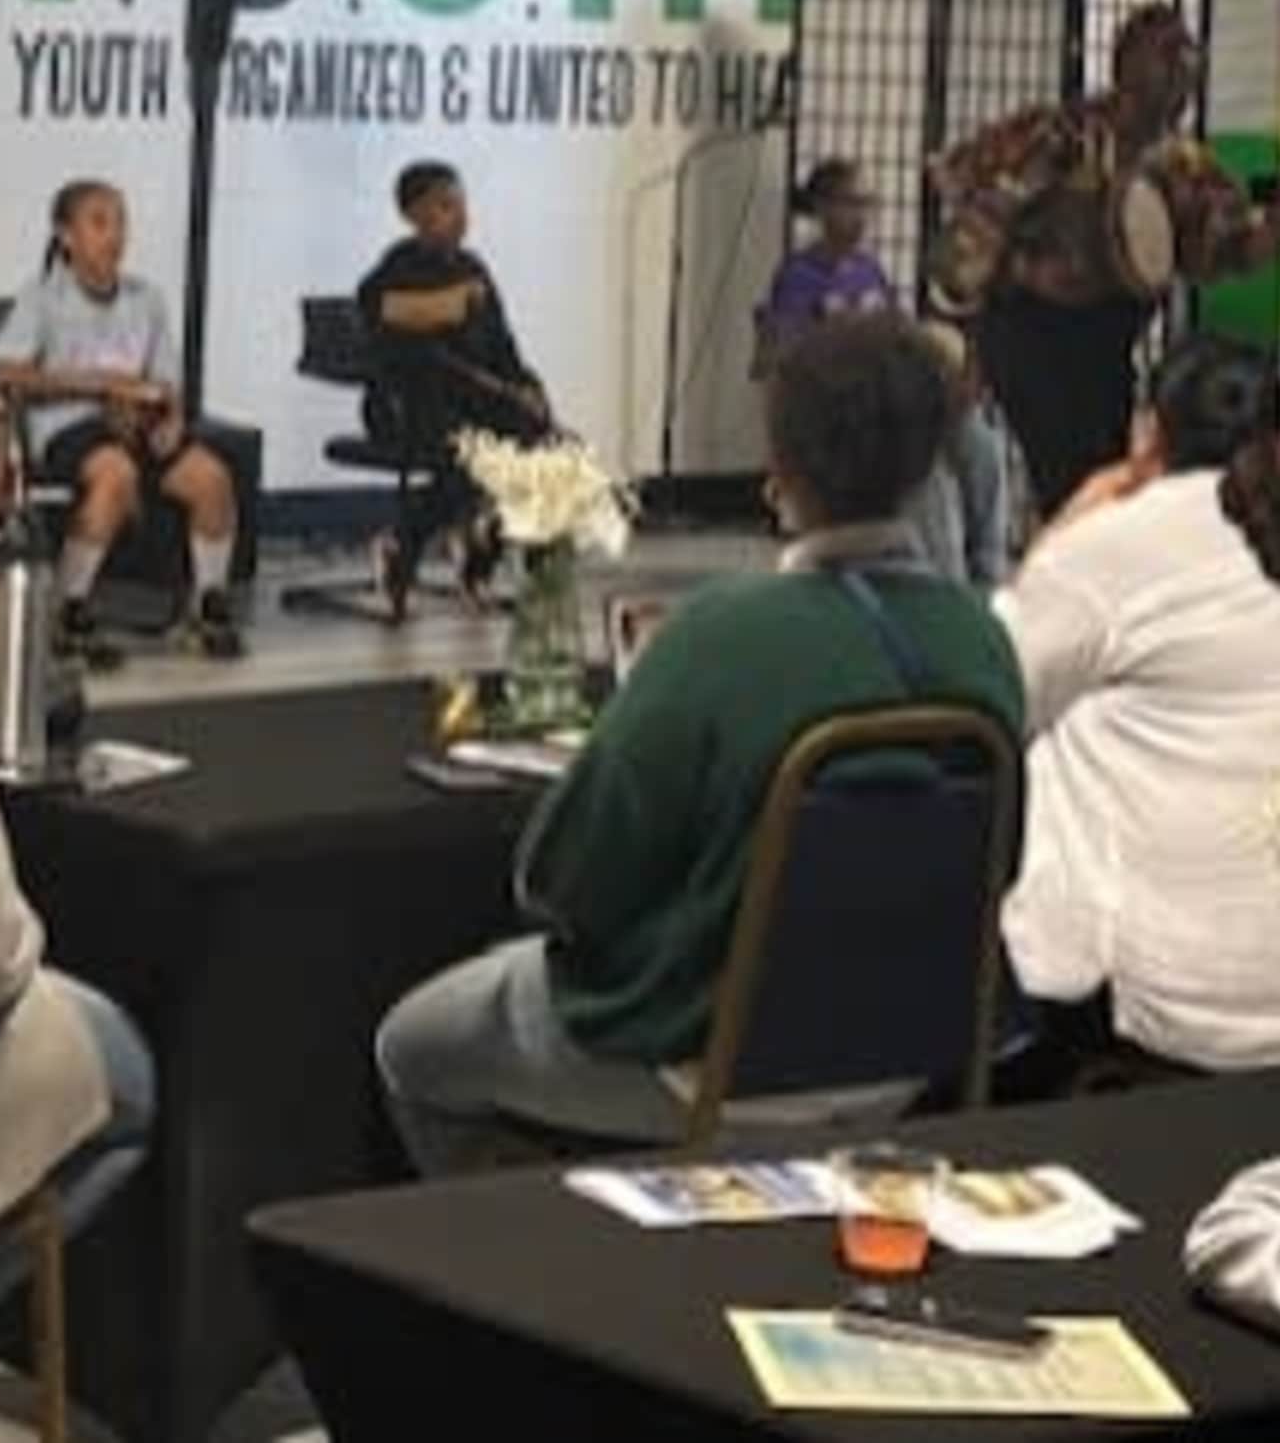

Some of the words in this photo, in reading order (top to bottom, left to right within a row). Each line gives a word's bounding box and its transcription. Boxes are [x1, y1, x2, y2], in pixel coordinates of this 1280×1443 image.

[14, 31, 169, 119] YOUTH
[188, 37, 426, 122] RGANIZED
[440, 43, 470, 124] &
[487, 42, 634, 127] UNITED
[648, 47, 701, 129] TO
